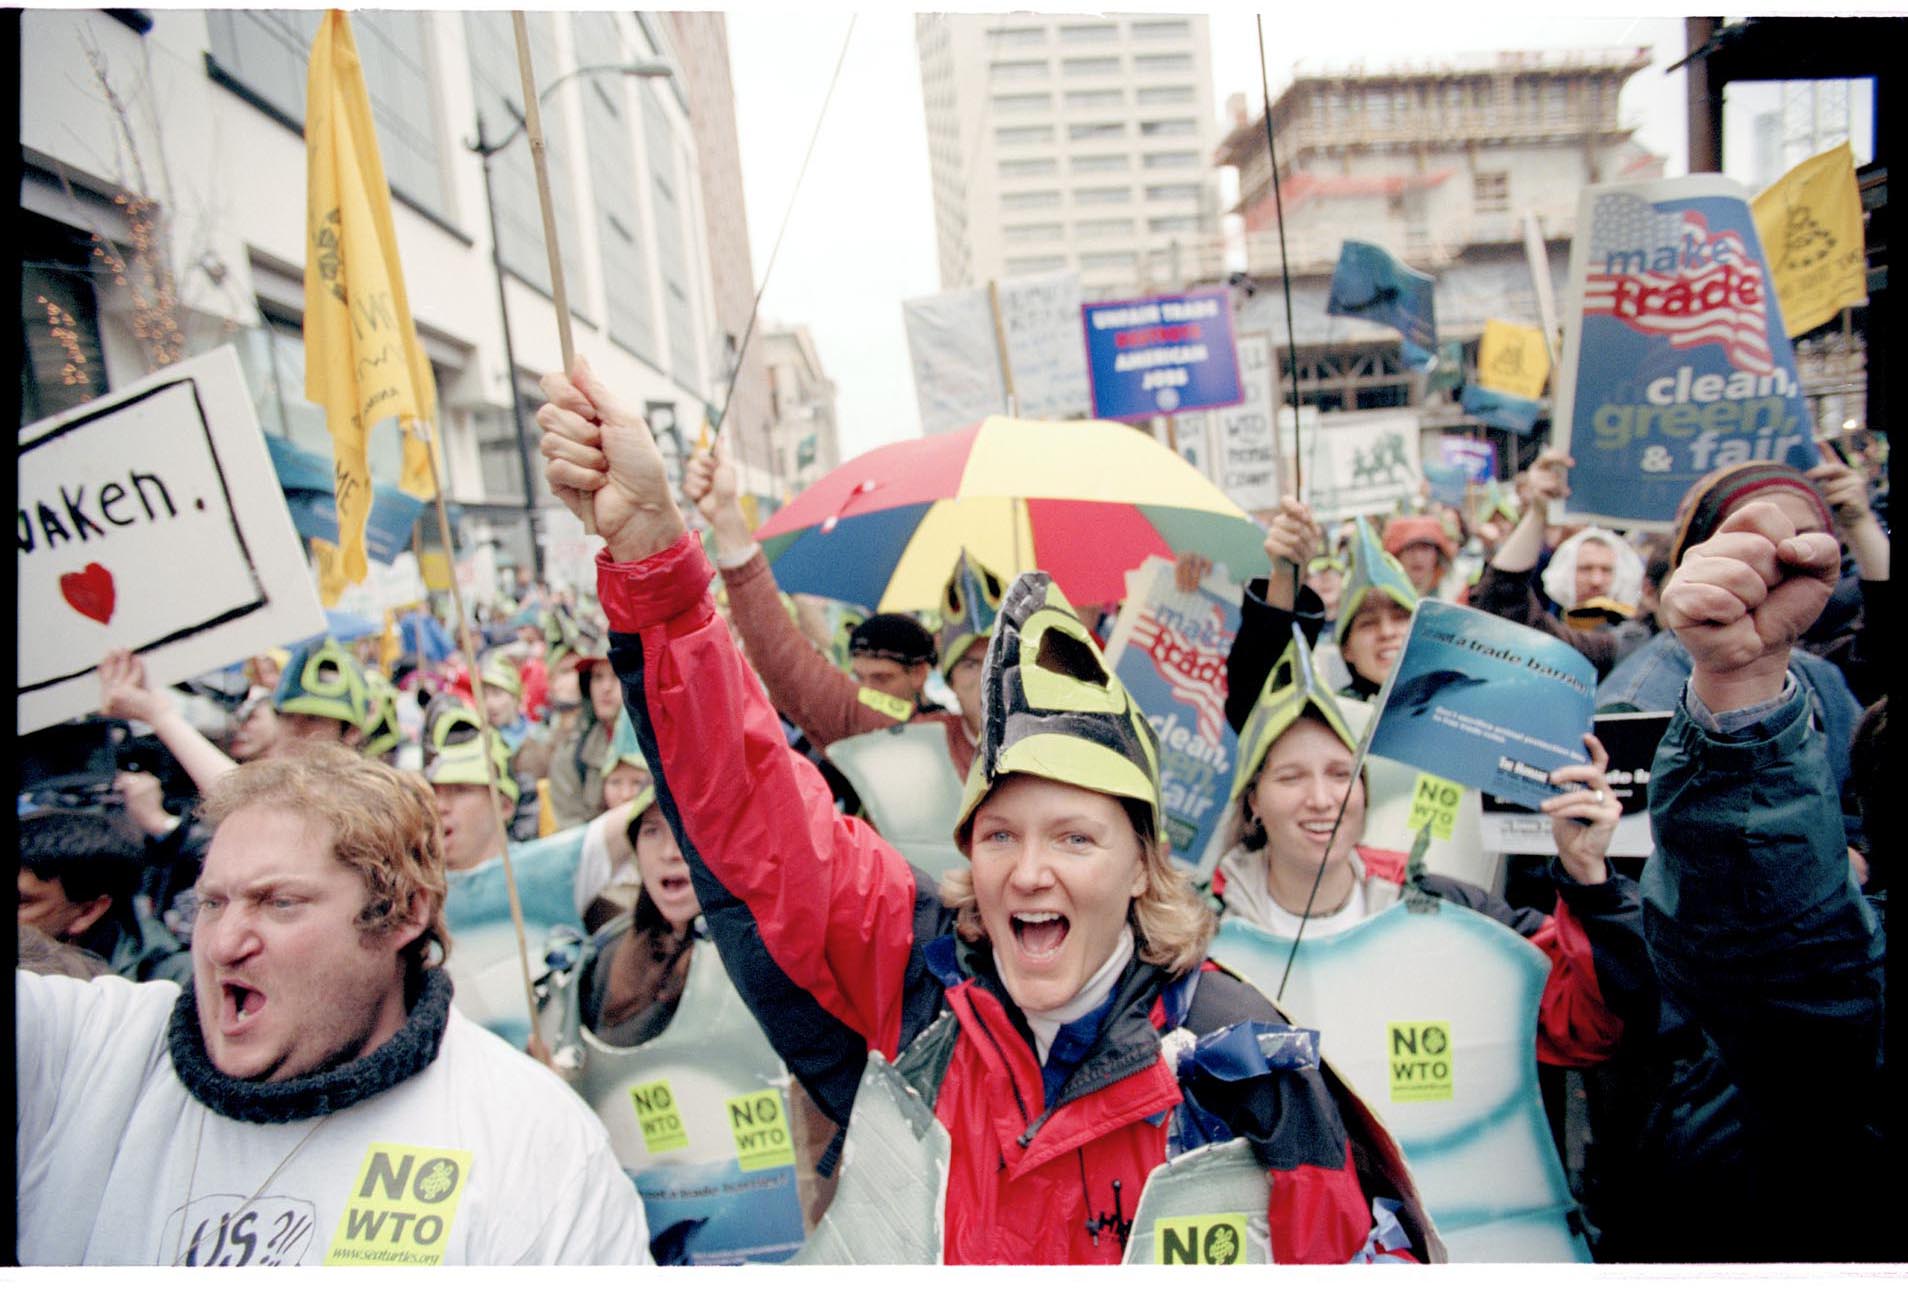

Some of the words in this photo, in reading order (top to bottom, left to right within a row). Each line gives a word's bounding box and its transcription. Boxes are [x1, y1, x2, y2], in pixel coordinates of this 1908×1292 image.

[1607, 231, 1731, 274] make
[1612, 265, 1760, 319] trade
[1115, 344, 1209, 373] AMERICAN
[1646, 366, 1798, 405] clean,
[1593, 397, 1796, 450] green,
[1640, 445, 1673, 472] &
[1690, 427, 1801, 469] fair
[1151, 625, 1229, 696] trad
[1469, 640, 1523, 664] trade
[1419, 780, 1459, 807] NO
[1414, 803, 1453, 824] WTO
[1392, 1026, 1446, 1056] NO
[1393, 1062, 1447, 1080] WTO
[634, 1085, 672, 1115] NO
[731, 1097, 778, 1128] NO
[642, 1115, 680, 1136] WTO
[738, 1128, 785, 1149] WTO
[358, 1152, 460, 1204] NO
[346, 1208, 444, 1246] WTO
[1163, 1223, 1240, 1266] NO
